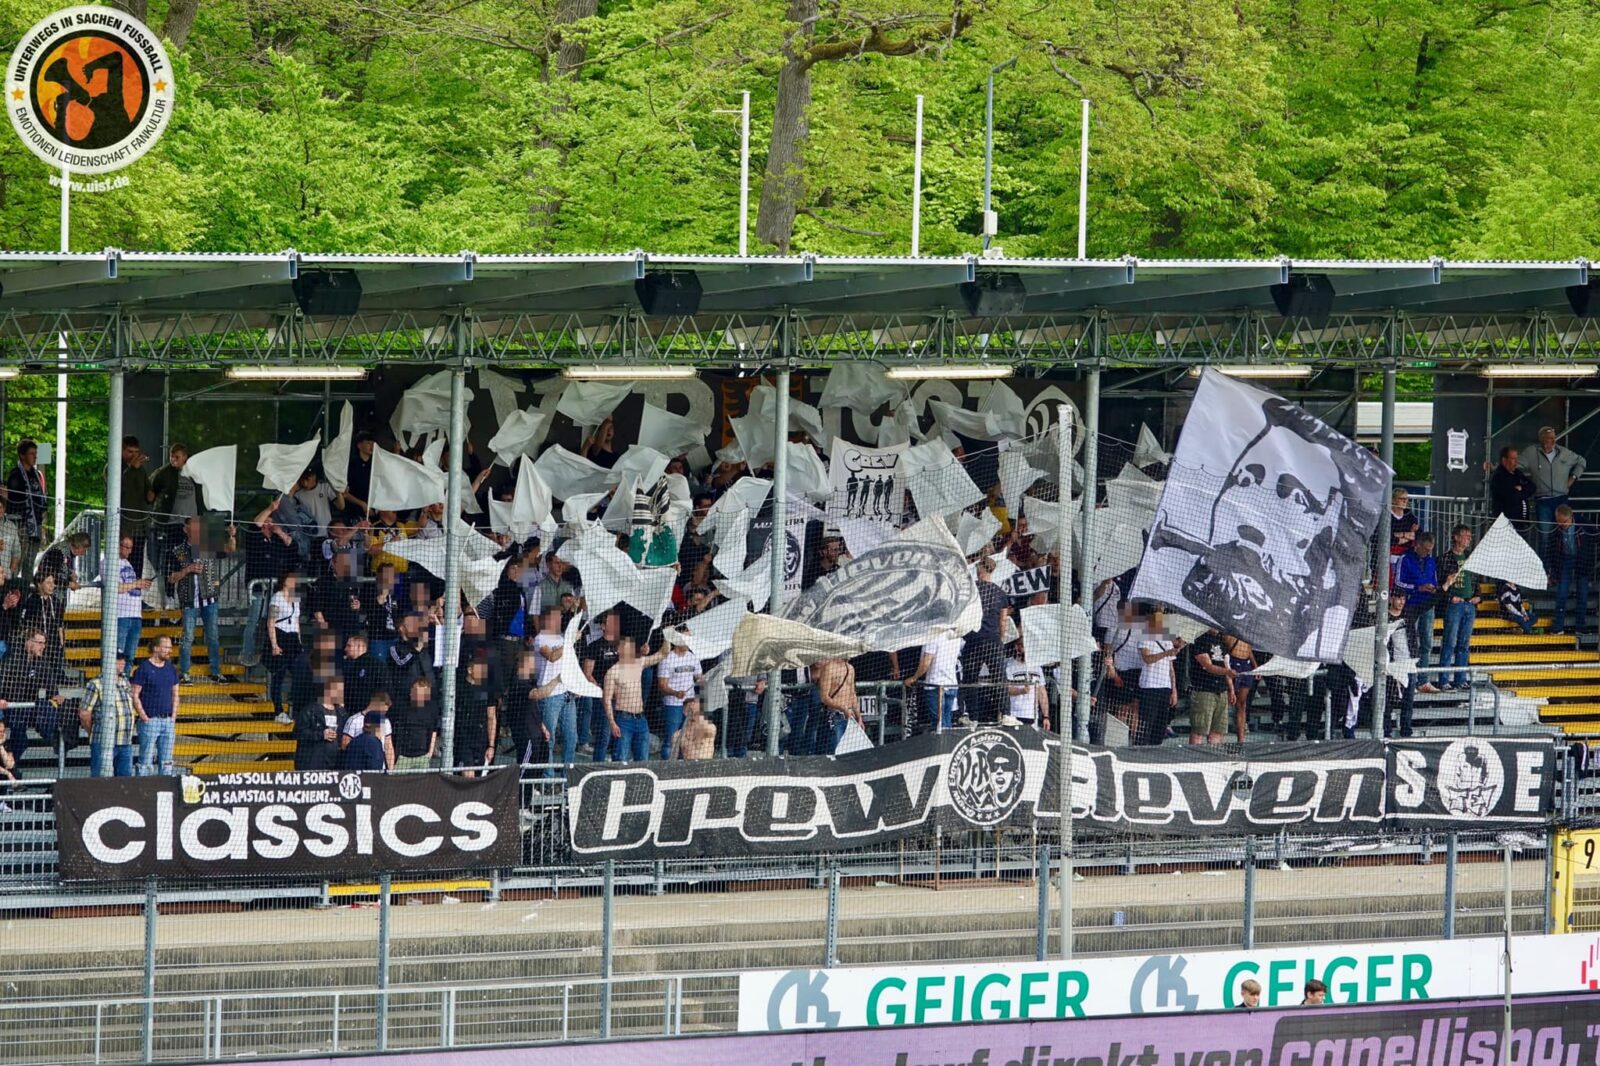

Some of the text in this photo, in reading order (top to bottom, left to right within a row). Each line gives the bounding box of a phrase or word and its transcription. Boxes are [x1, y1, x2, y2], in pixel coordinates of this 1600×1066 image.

[202, 791, 220, 804] AM
[222, 790, 275, 804] SAMSTAG
[245, 773, 273, 785] SOLL
[275, 773, 300, 785] MAN
[303, 772, 339, 785] SONST
[571, 754, 941, 854] Crew
[1033, 740, 1386, 824] Eleven
[82, 787, 498, 864] classics
[1584, 838, 1595, 869] 9
[867, 970, 1090, 1026] GEIGER
